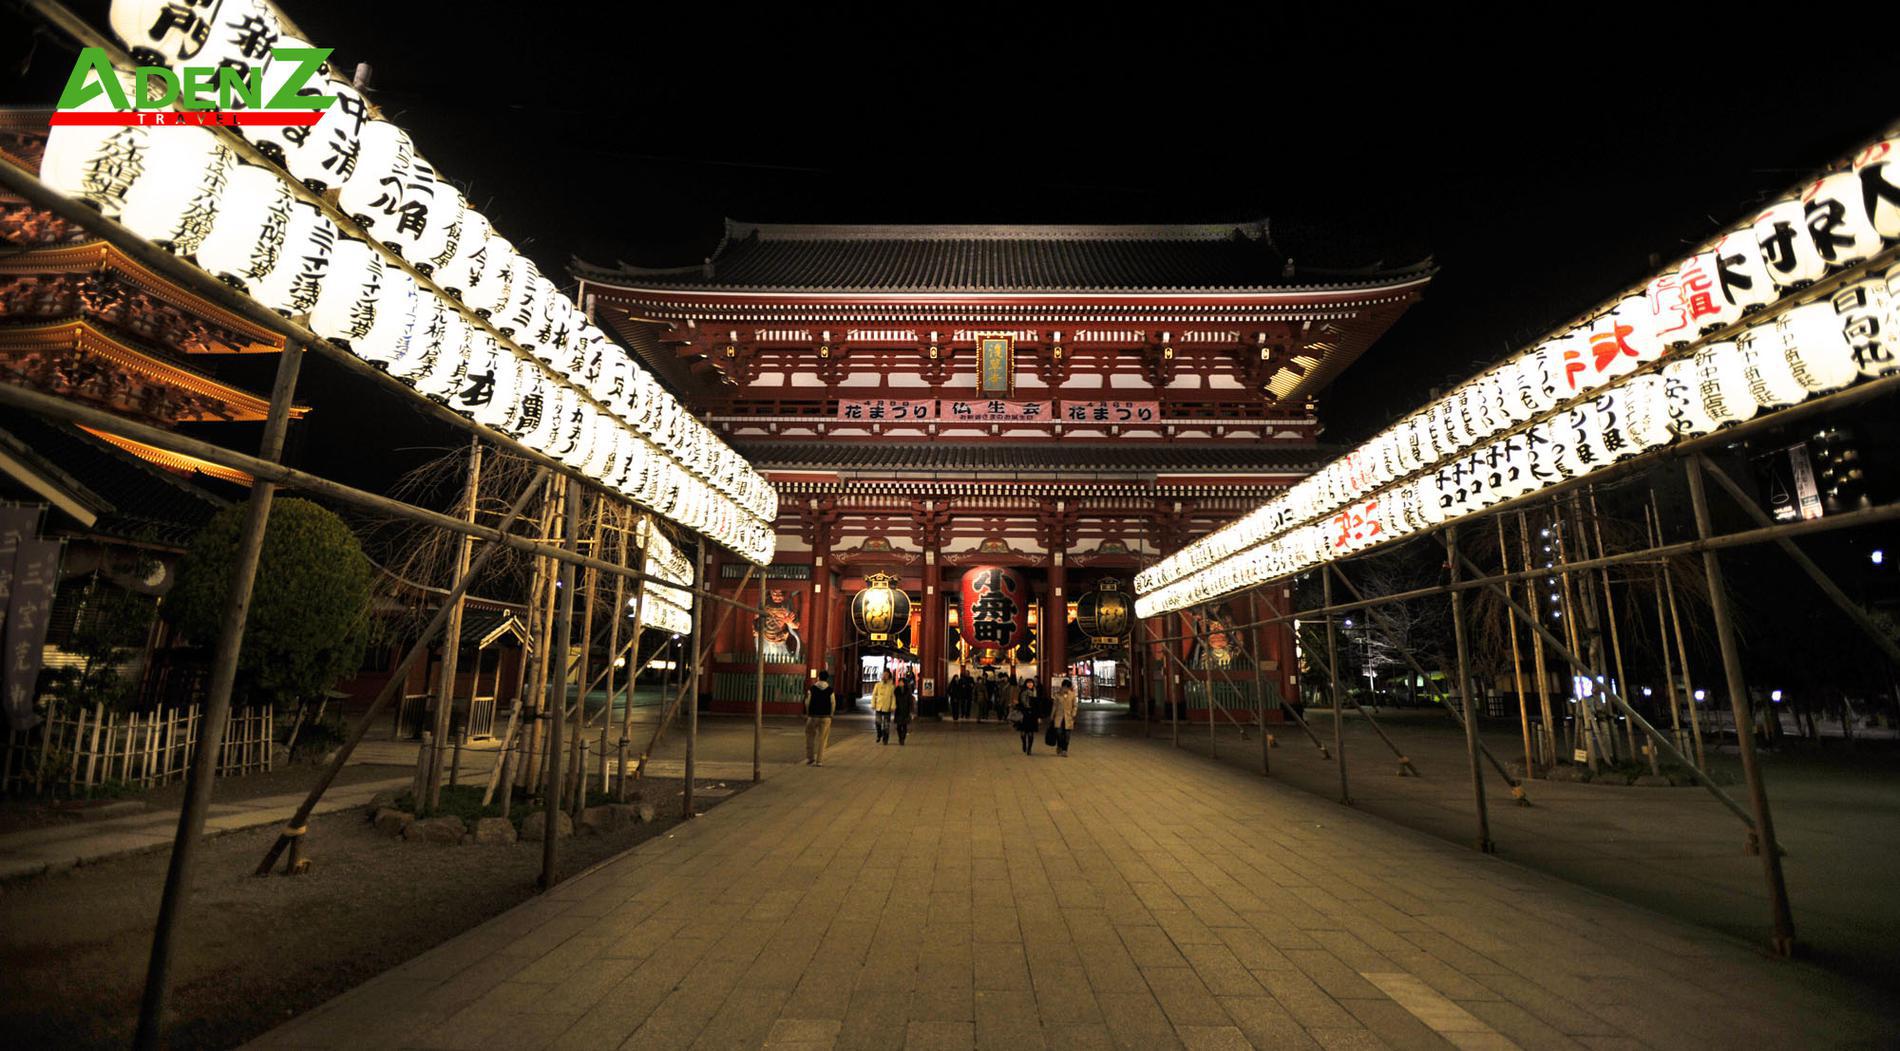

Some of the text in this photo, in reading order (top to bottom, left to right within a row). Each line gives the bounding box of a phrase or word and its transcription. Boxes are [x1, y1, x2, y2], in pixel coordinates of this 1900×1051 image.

[845, 405, 927, 418] 花まつり
[952, 401, 1041, 415] 仏生会
[1068, 406, 1152, 421] 花まつり
[971, 567, 1018, 645] 小舟町
